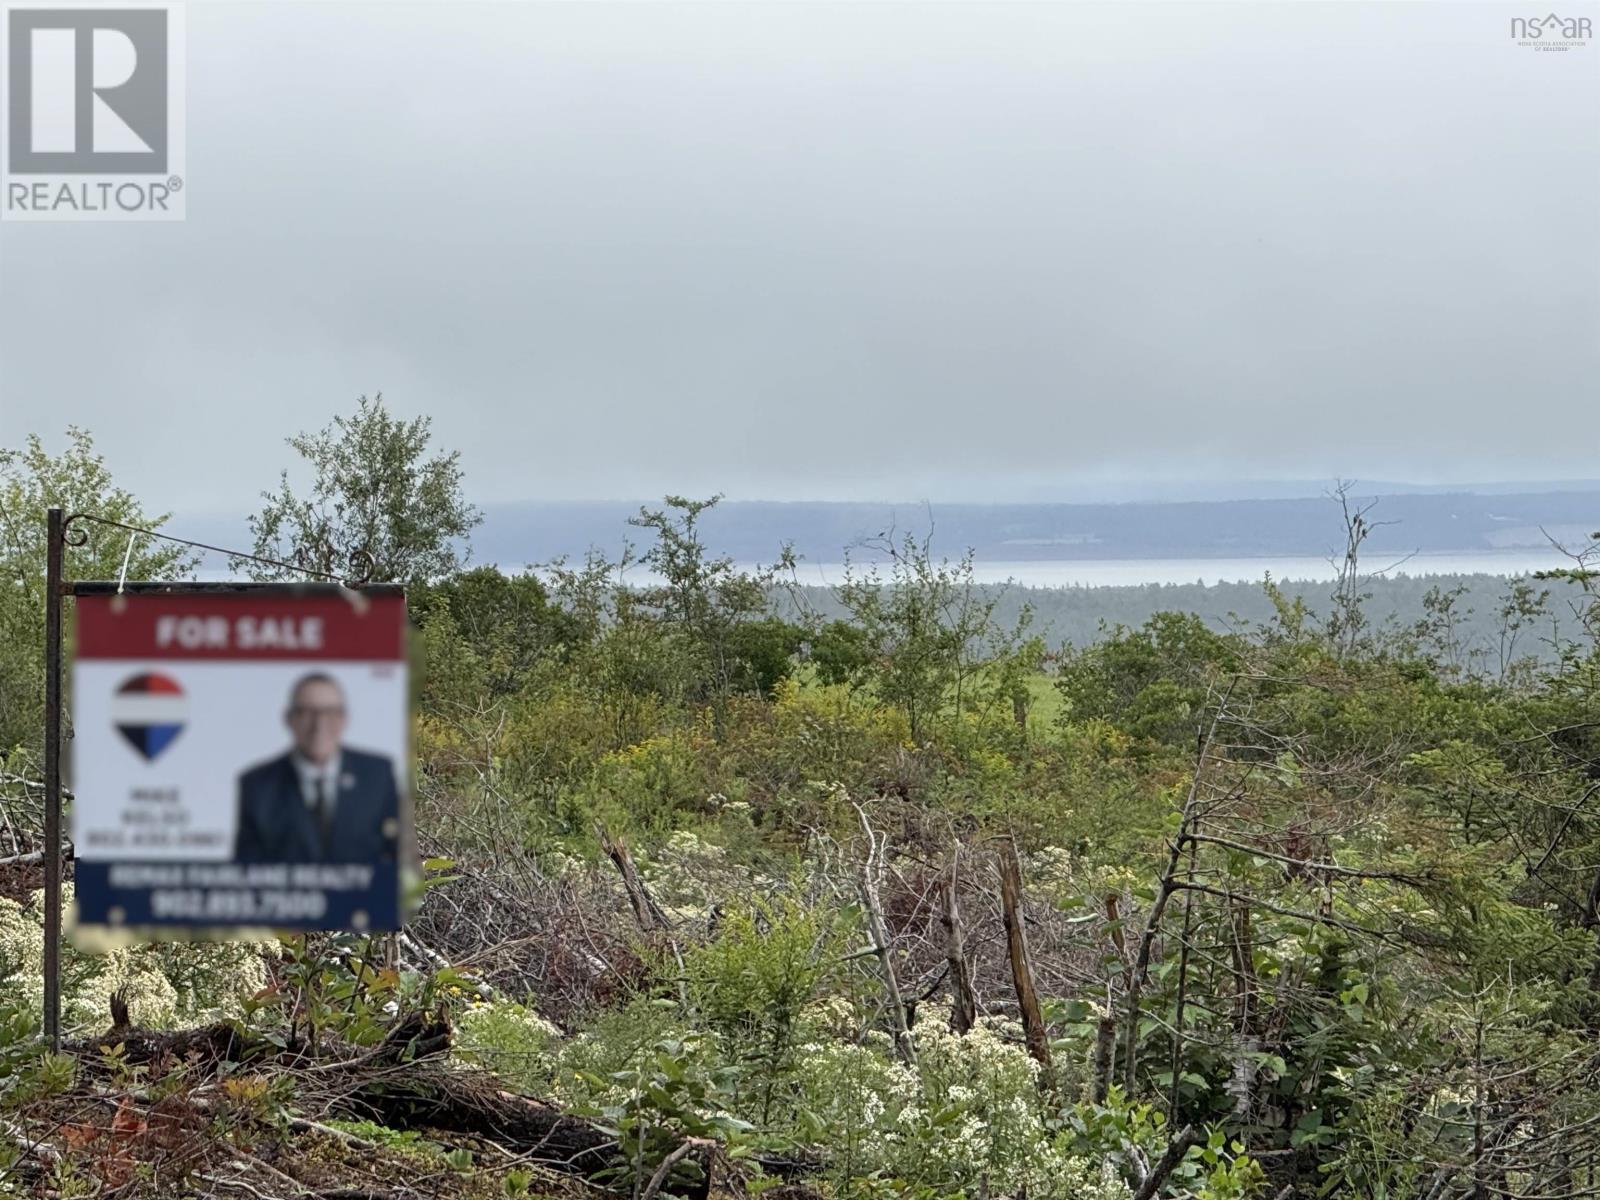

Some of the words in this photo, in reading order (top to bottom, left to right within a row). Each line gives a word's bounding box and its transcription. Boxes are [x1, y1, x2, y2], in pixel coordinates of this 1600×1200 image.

[157, 616, 229, 649] FOR
[236, 617, 324, 650] SALE
[292, 865, 375, 890] REALTY
